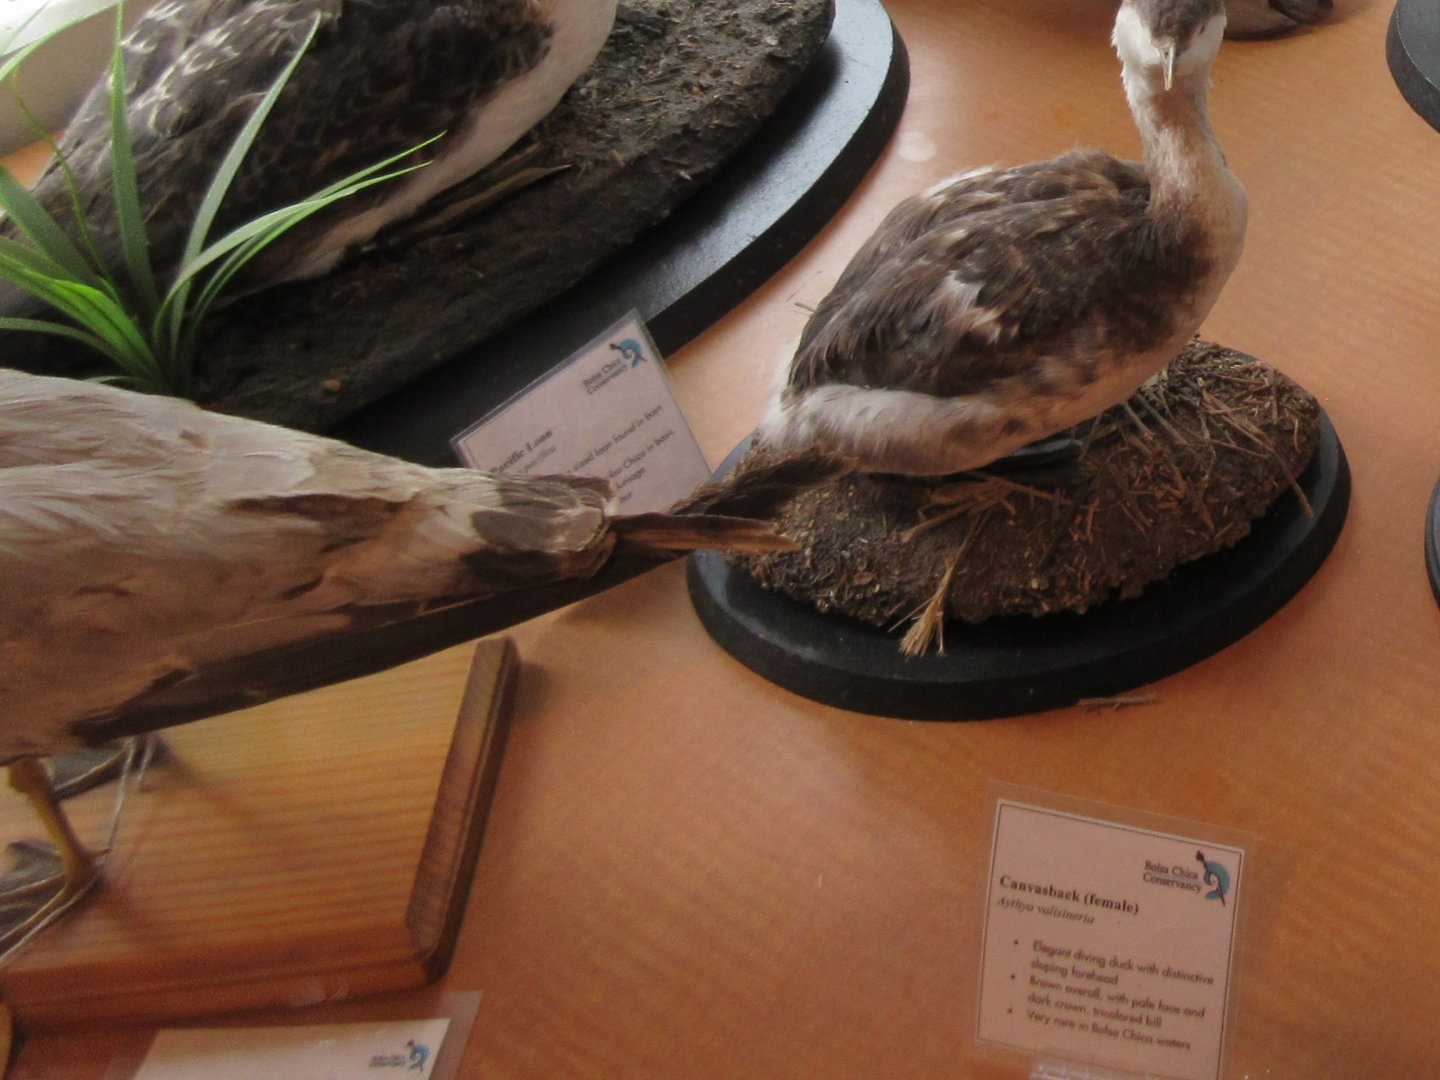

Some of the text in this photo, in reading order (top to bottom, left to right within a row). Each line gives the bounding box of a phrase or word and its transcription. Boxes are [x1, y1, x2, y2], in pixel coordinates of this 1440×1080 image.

[526, 430, 553, 451] Loon
[1000, 875, 1138, 914] Canvasback (female)
